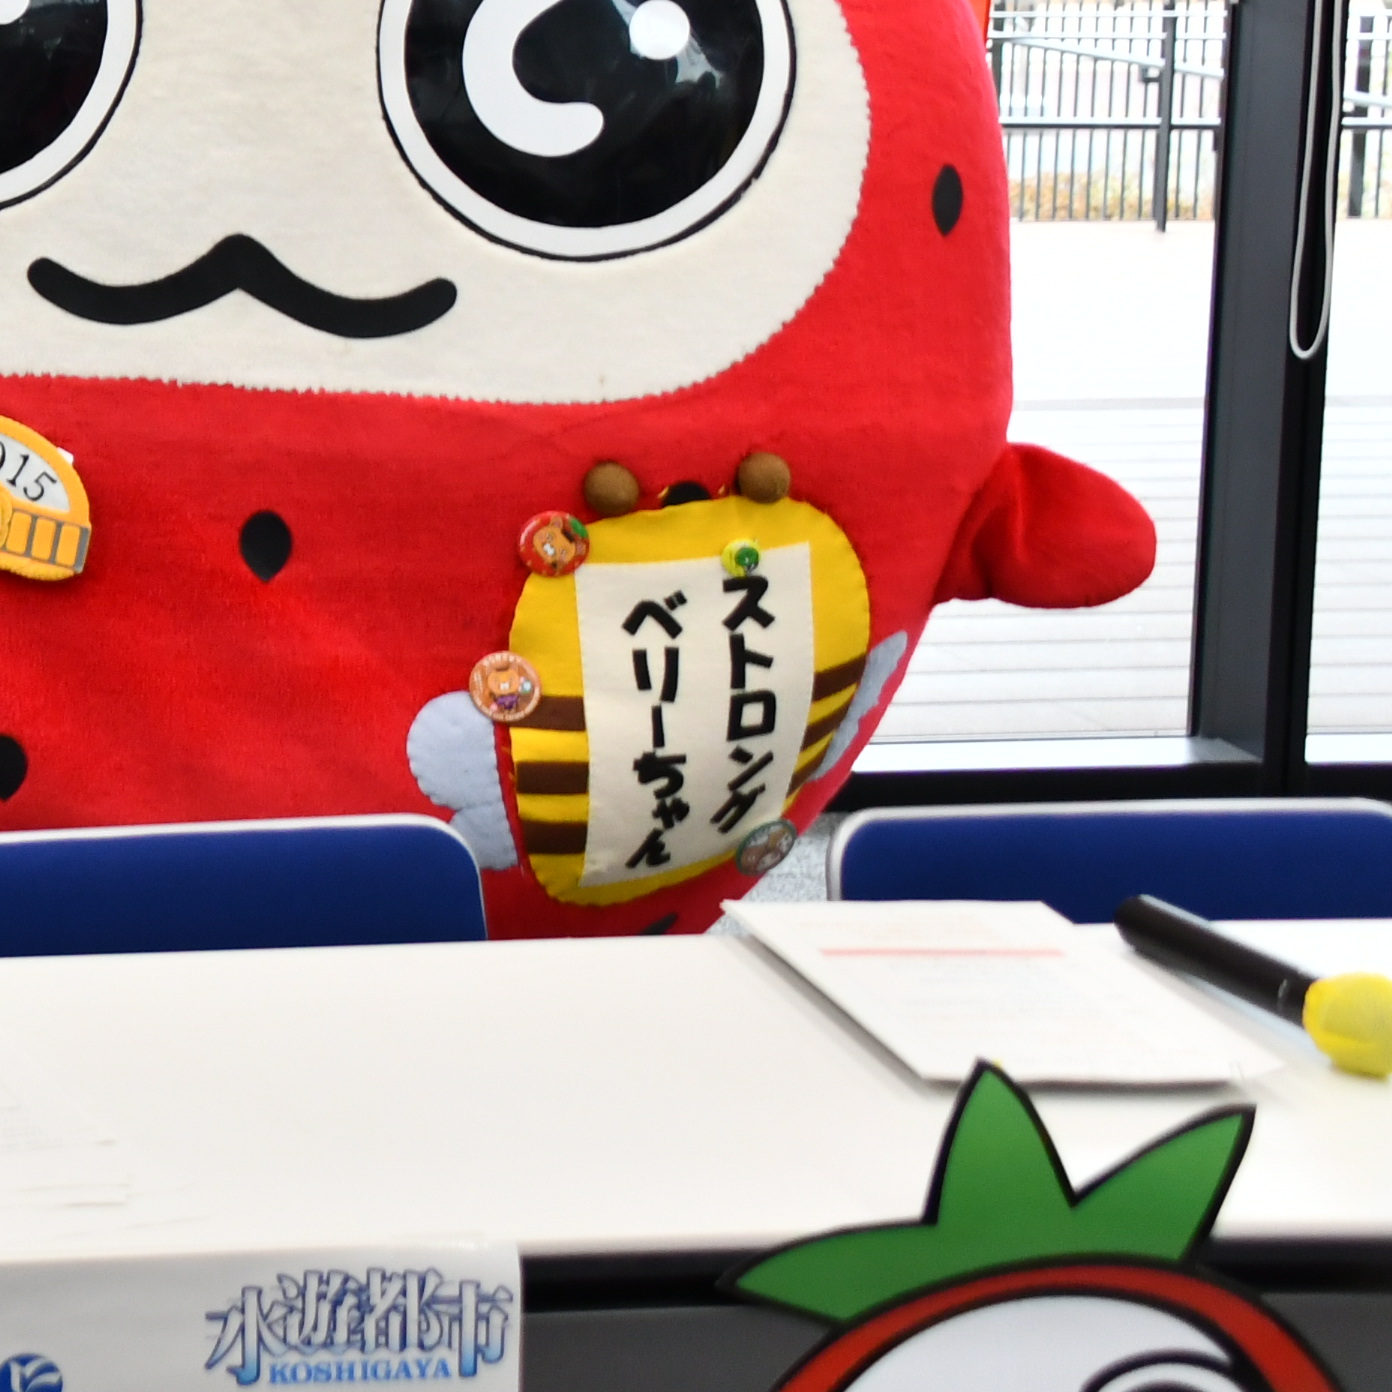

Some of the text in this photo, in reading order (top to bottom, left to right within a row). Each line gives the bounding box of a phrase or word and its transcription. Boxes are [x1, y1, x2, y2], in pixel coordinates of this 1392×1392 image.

[621, 589, 691, 870] ベリーちゃん
[712, 573, 777, 834] ストロング
[268, 1357, 453, 1385] KOSHIGAYA
